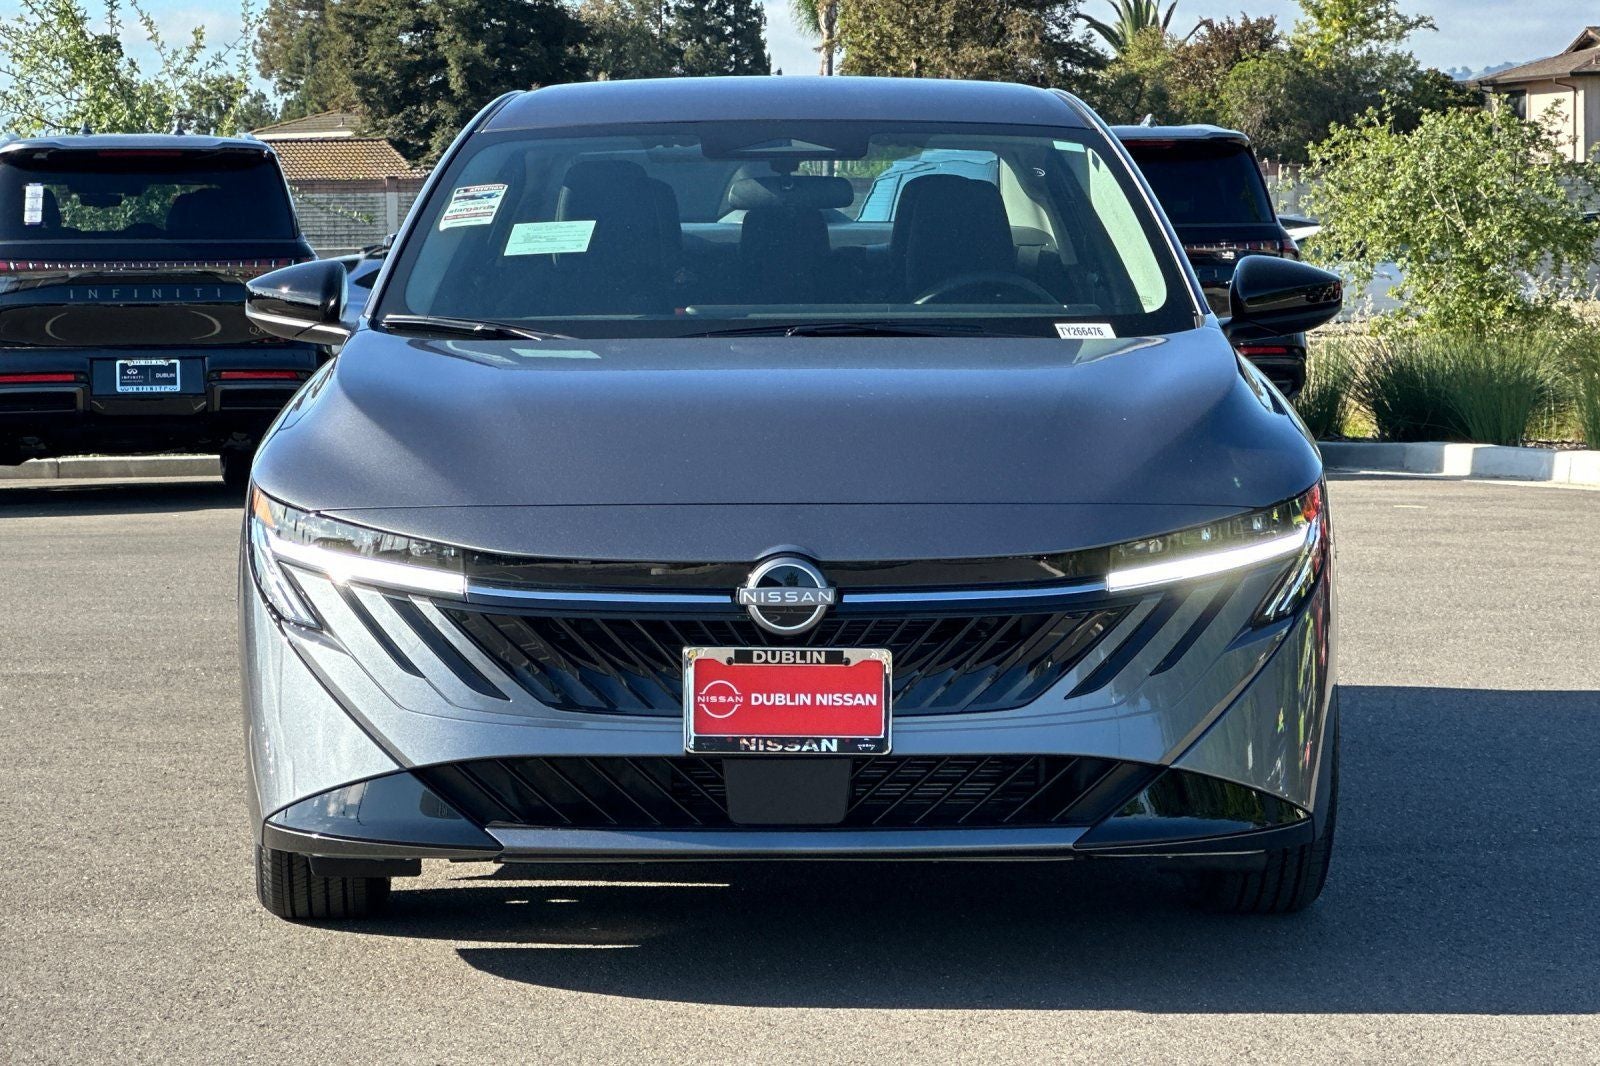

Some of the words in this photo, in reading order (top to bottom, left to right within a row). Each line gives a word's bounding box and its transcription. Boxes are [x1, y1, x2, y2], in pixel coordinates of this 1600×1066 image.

[69, 287, 221, 299] INFINITI
[743, 591, 832, 603] NISSAN
[752, 650, 826, 664] DUBLIN
[697, 695, 743, 703] NISSAN
[751, 693, 811, 706] DUBLIN
[816, 693, 877, 706] NISSAN
[739, 738, 838, 752] NISSAN
